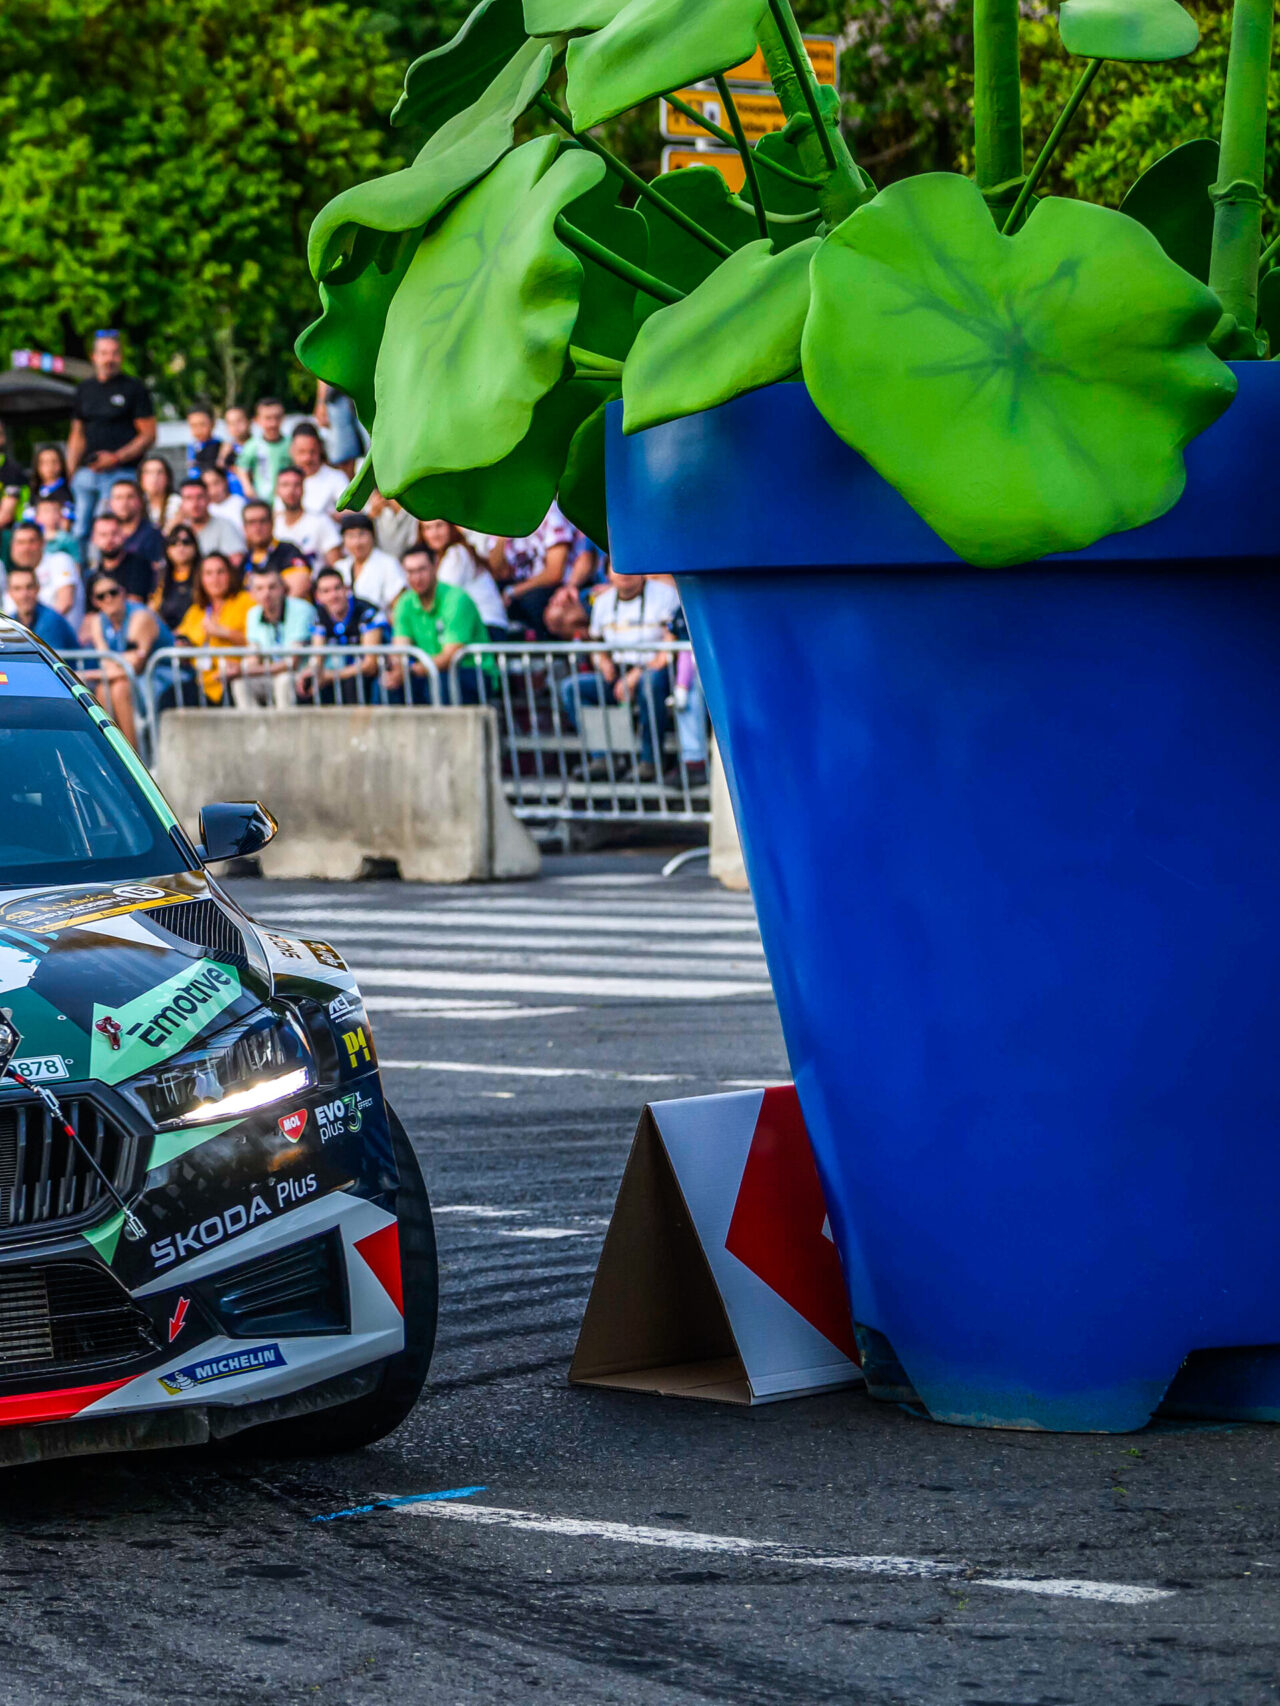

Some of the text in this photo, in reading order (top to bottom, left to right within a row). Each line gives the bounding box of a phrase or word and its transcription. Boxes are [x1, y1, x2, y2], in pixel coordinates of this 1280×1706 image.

[120, 886, 158, 898] 15
[283, 1114, 301, 1132] MOL
[314, 1099, 345, 1126] EVO
[320, 1120, 345, 1144] plus
[277, 1172, 318, 1209] Plus
[195, 1349, 276, 1381] MICHELIN
